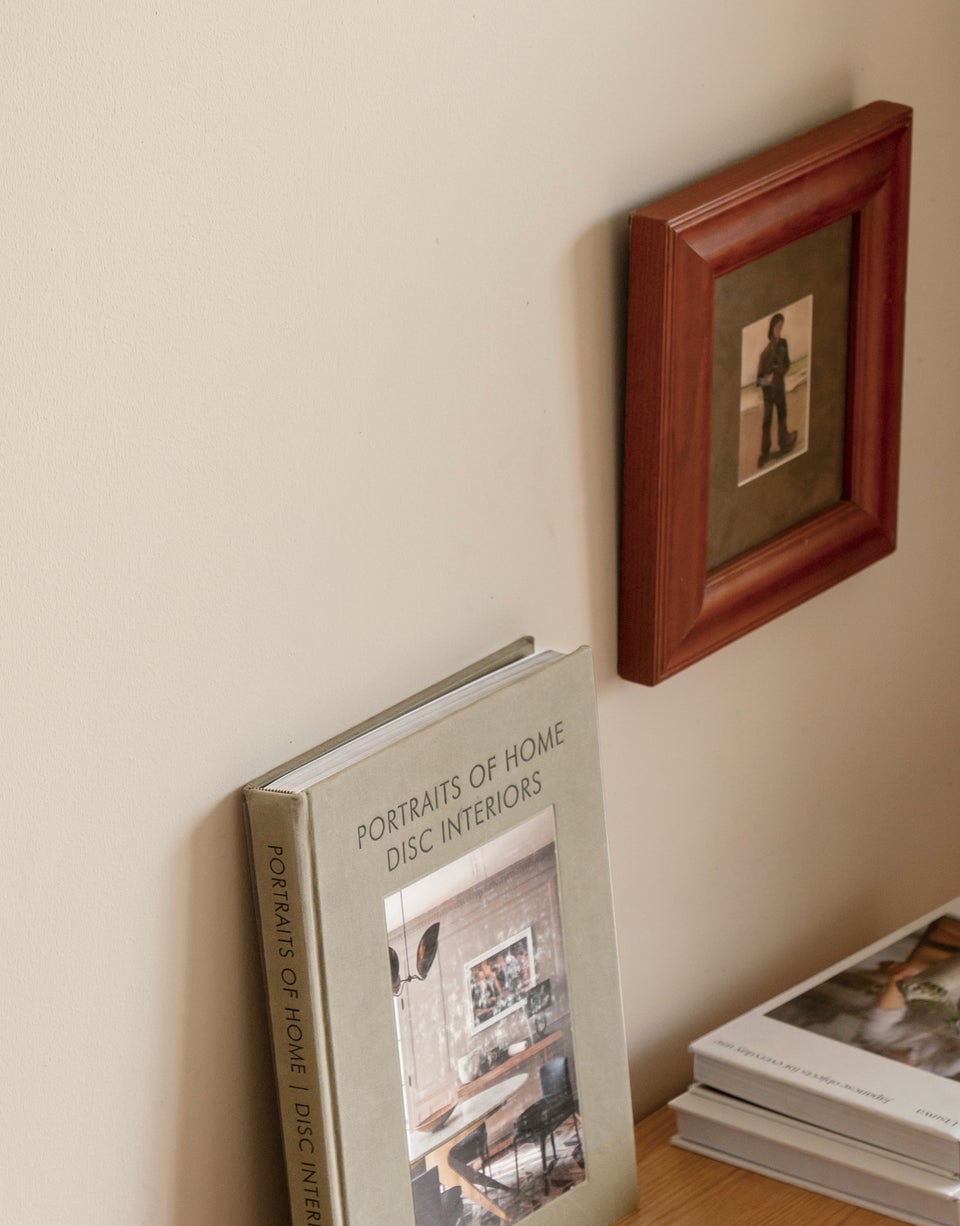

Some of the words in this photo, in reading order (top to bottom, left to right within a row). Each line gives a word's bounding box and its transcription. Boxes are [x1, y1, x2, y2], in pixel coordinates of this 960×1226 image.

[357, 774, 462, 849] PORTRAITS
[469, 755, 497, 789] OF
[505, 720, 565, 772] HOME
[386, 828, 433, 872] DISC
[441, 770, 543, 844] INTERIORS
[267, 845, 295, 958] PORTRAITS
[281, 967, 299, 999] OF
[286, 1007, 308, 1074] HOME
[294, 1102, 316, 1155] DISC
